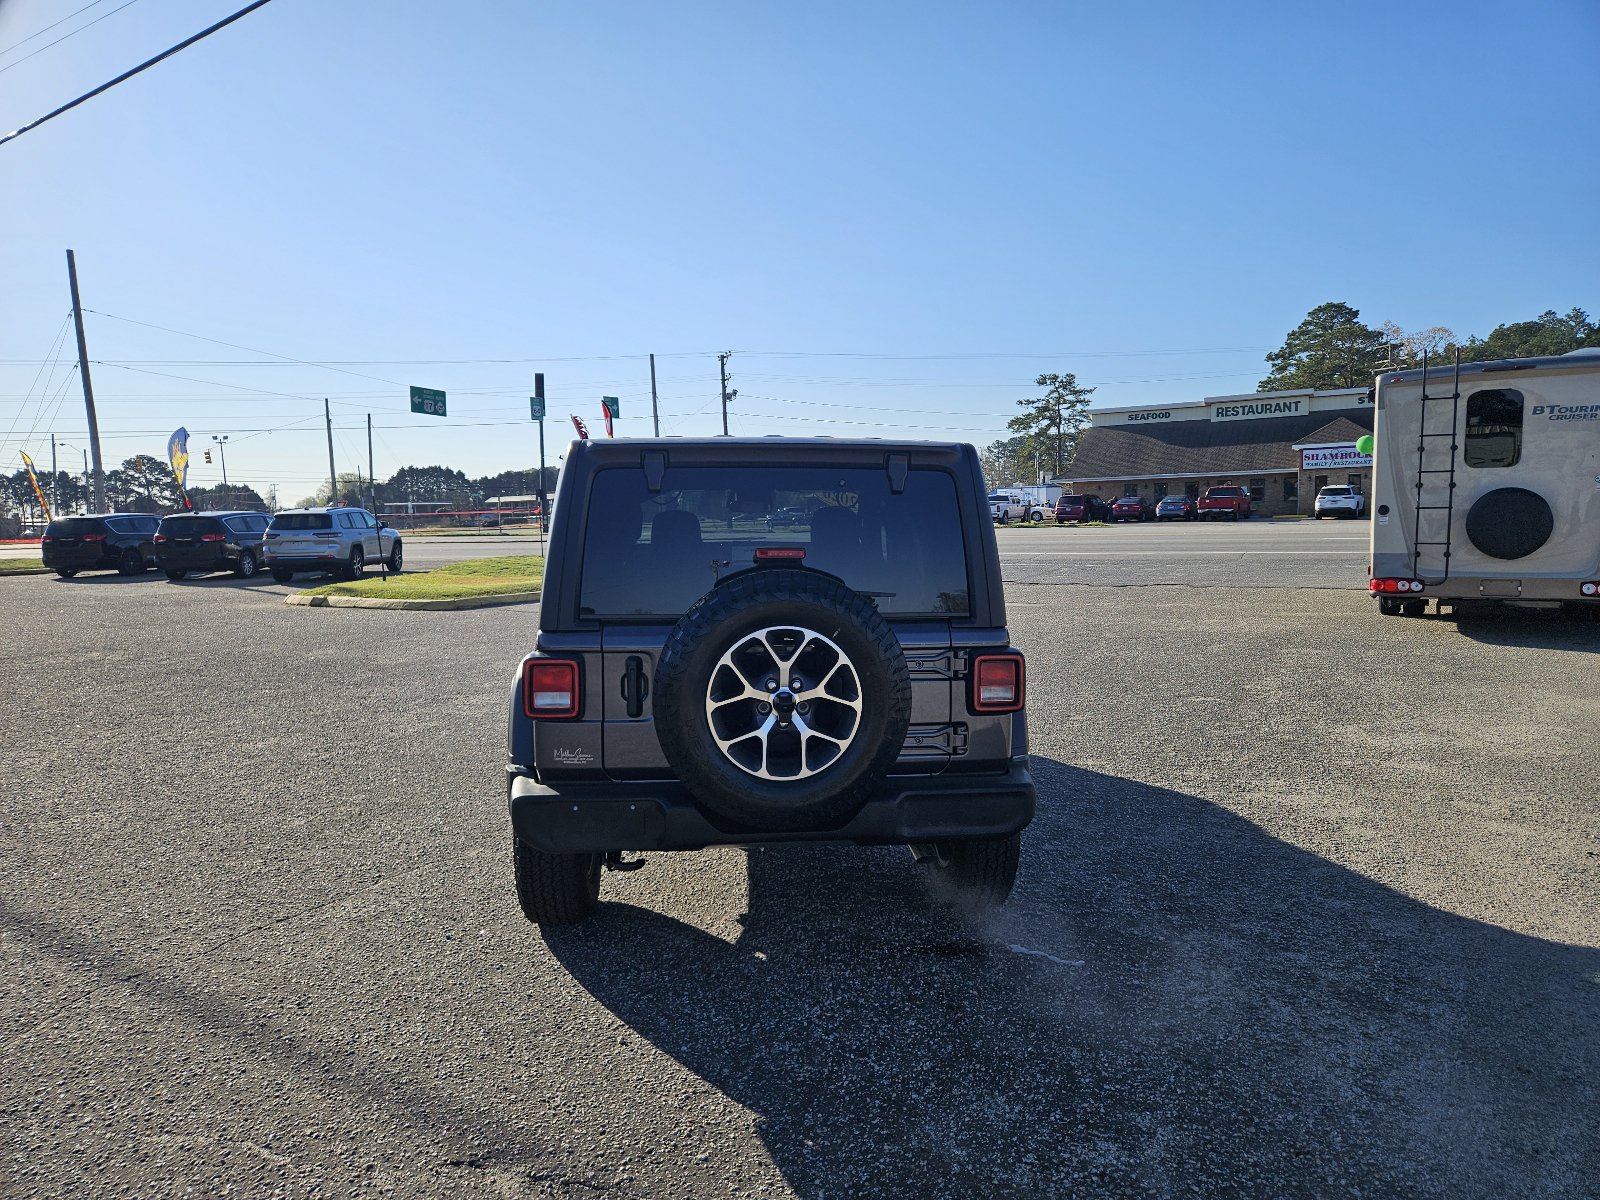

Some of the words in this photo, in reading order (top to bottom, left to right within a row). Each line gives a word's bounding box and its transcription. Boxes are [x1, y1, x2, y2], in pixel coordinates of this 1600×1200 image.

[1216, 401, 1301, 417] RESTAURANT
[1127, 411, 1171, 421] SEAFOOD
[1548, 412, 1599, 421] CRUISER
